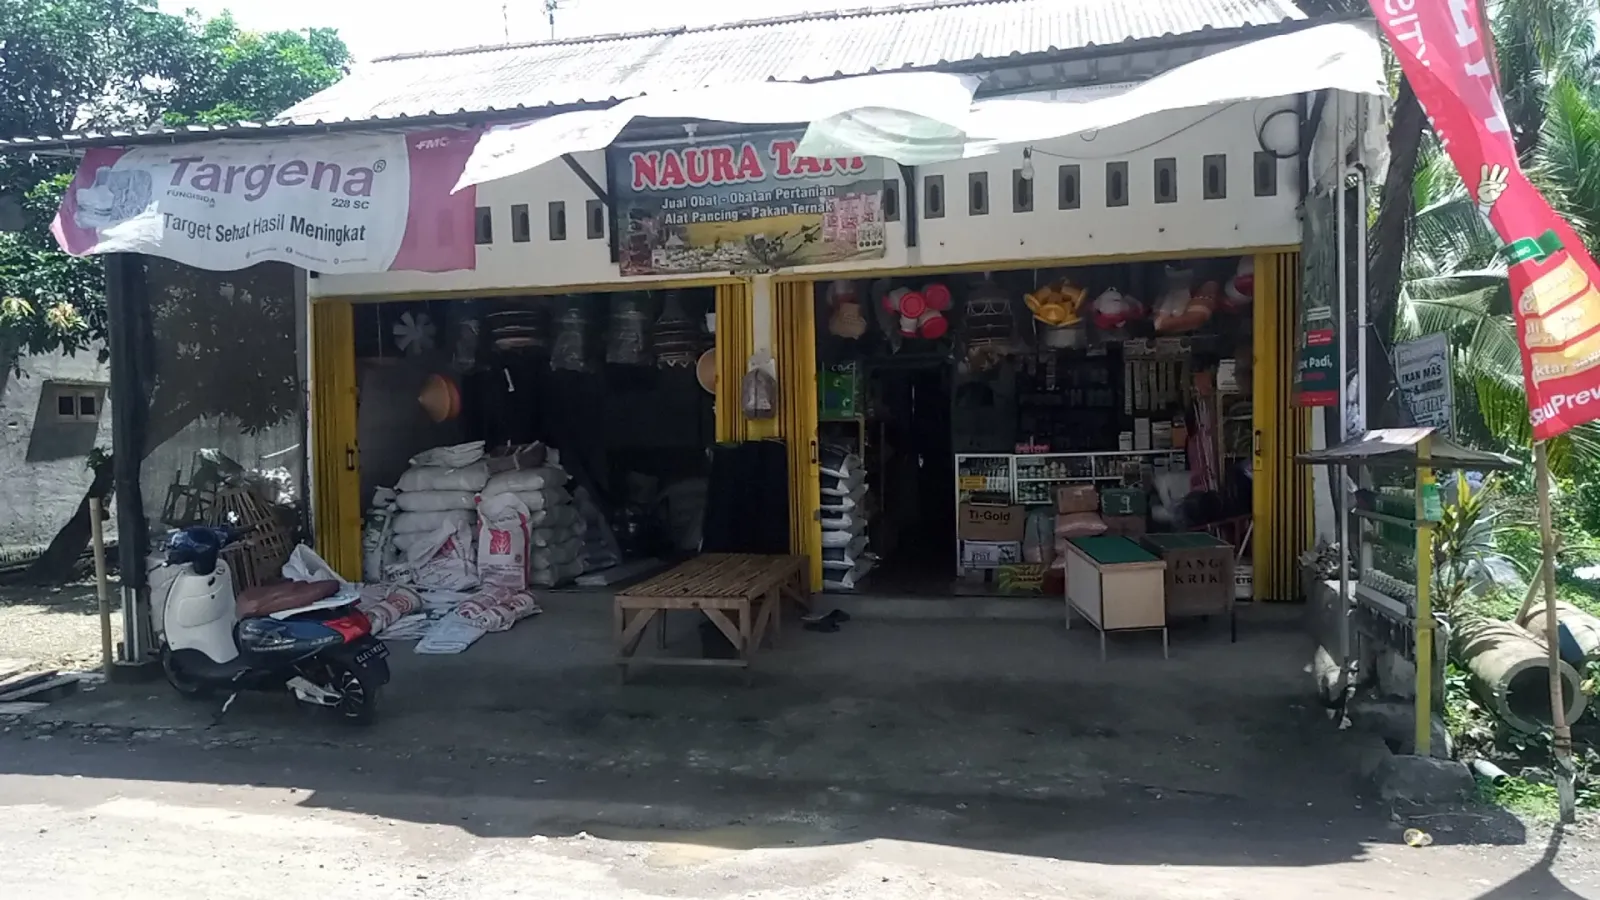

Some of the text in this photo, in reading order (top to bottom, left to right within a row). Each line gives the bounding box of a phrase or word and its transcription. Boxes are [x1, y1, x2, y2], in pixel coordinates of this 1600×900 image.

[169, 155, 374, 202] Targena
[631, 142, 766, 191] NAURA
[331, 197, 370, 209] 228 SC
[662, 197, 687, 210] Jual
[690, 194, 718, 207] Obat
[729, 191, 773, 205] Obatan
[775, 185, 835, 200] Pertanian
[664, 212, 690, 226] Alat
[691, 208, 739, 225] Pancing
[751, 205, 788, 219] Pakan
[791, 200, 834, 214] Ternak
[163, 211, 366, 246] Target Sehat Hasil Meningkat
[968, 509, 1010, 521] Ti-Gold
